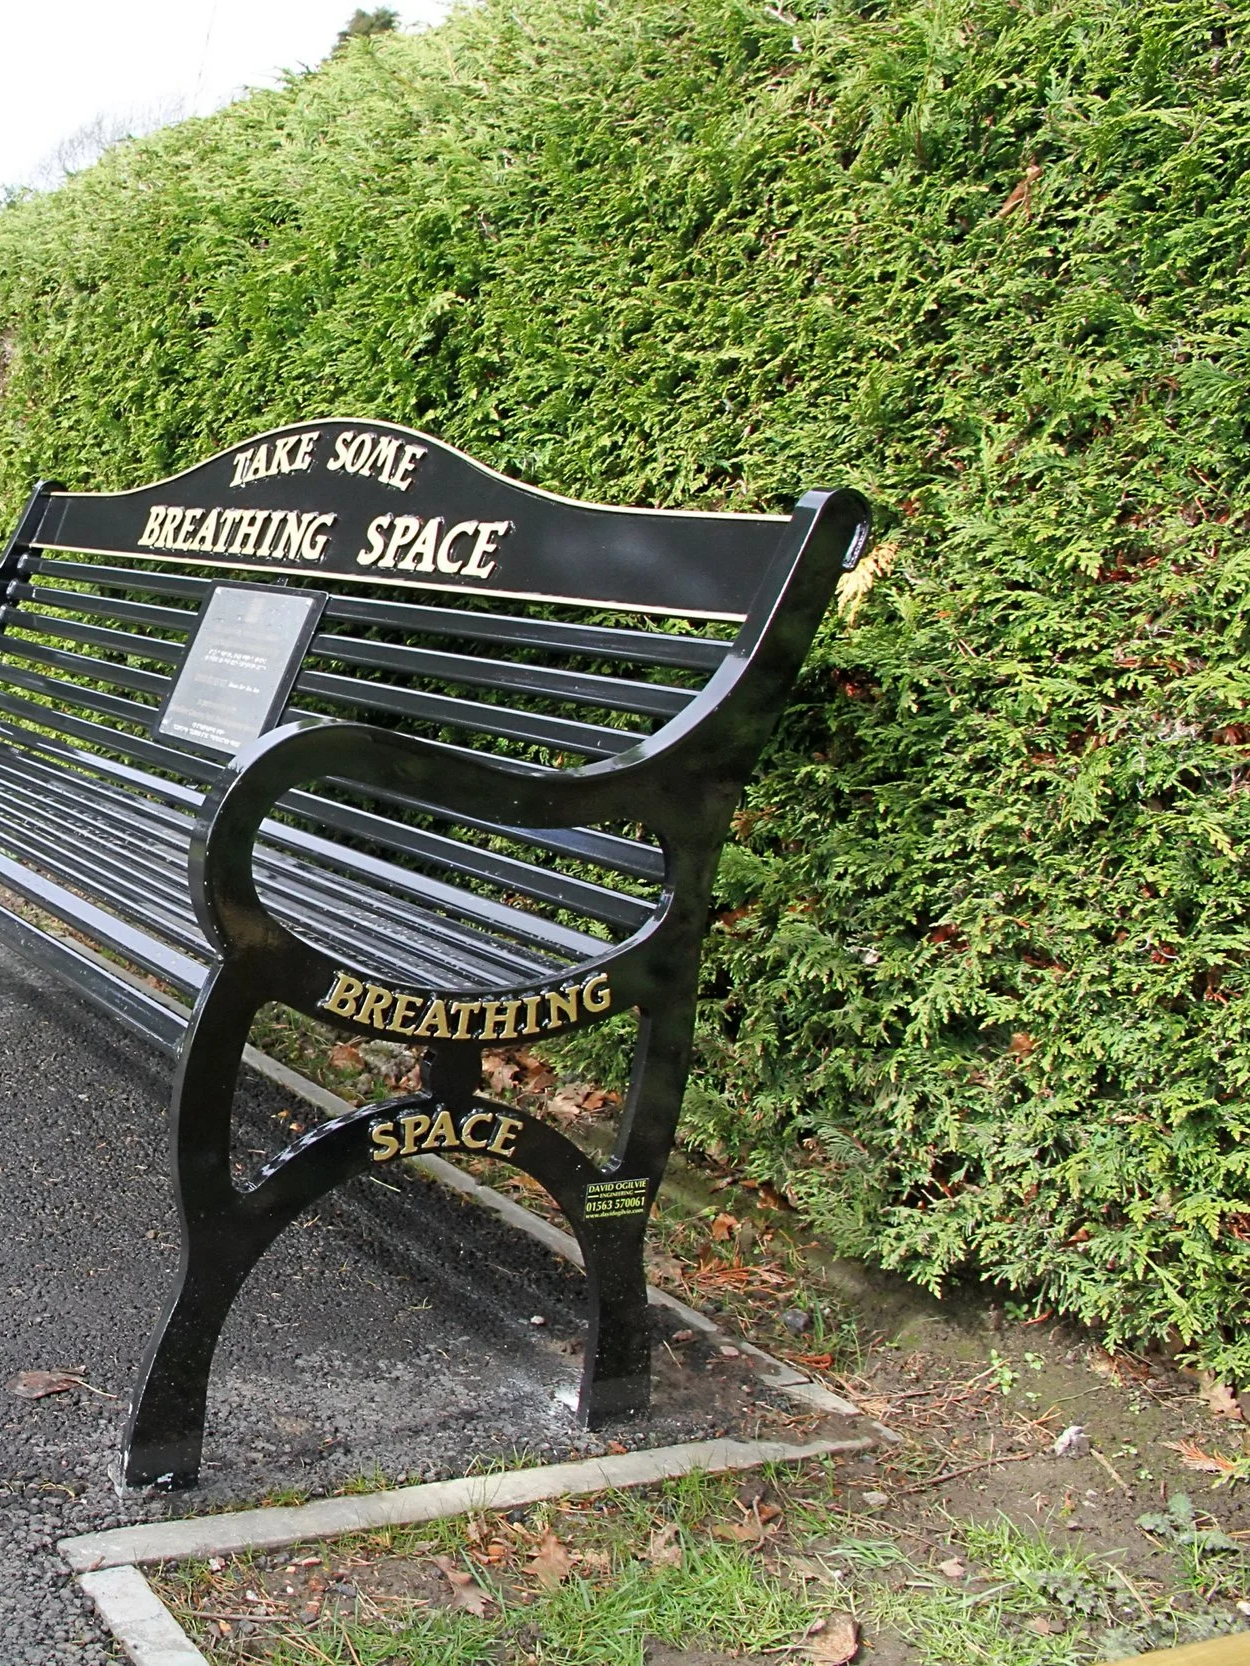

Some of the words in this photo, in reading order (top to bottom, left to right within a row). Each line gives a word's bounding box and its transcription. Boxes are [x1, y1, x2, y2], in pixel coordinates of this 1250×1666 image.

[229, 431, 320, 488] TAKE
[326, 430, 427, 492] SOME
[138, 505, 336, 562] BREATHING
[356, 513, 512, 580] SPACE
[325, 972, 612, 1040] BREATHING
[371, 1110, 524, 1162] SPACE
[588, 1183, 614, 1193] DAVID
[615, 1180, 647, 1191] OGILVIE
[599, 1190, 634, 1198] ENGINEERING
[585, 1208, 644, 1219] www.davidogilvie.com
[586, 1200, 613, 1212] 01563
[614, 1196, 645, 1209] 570061
